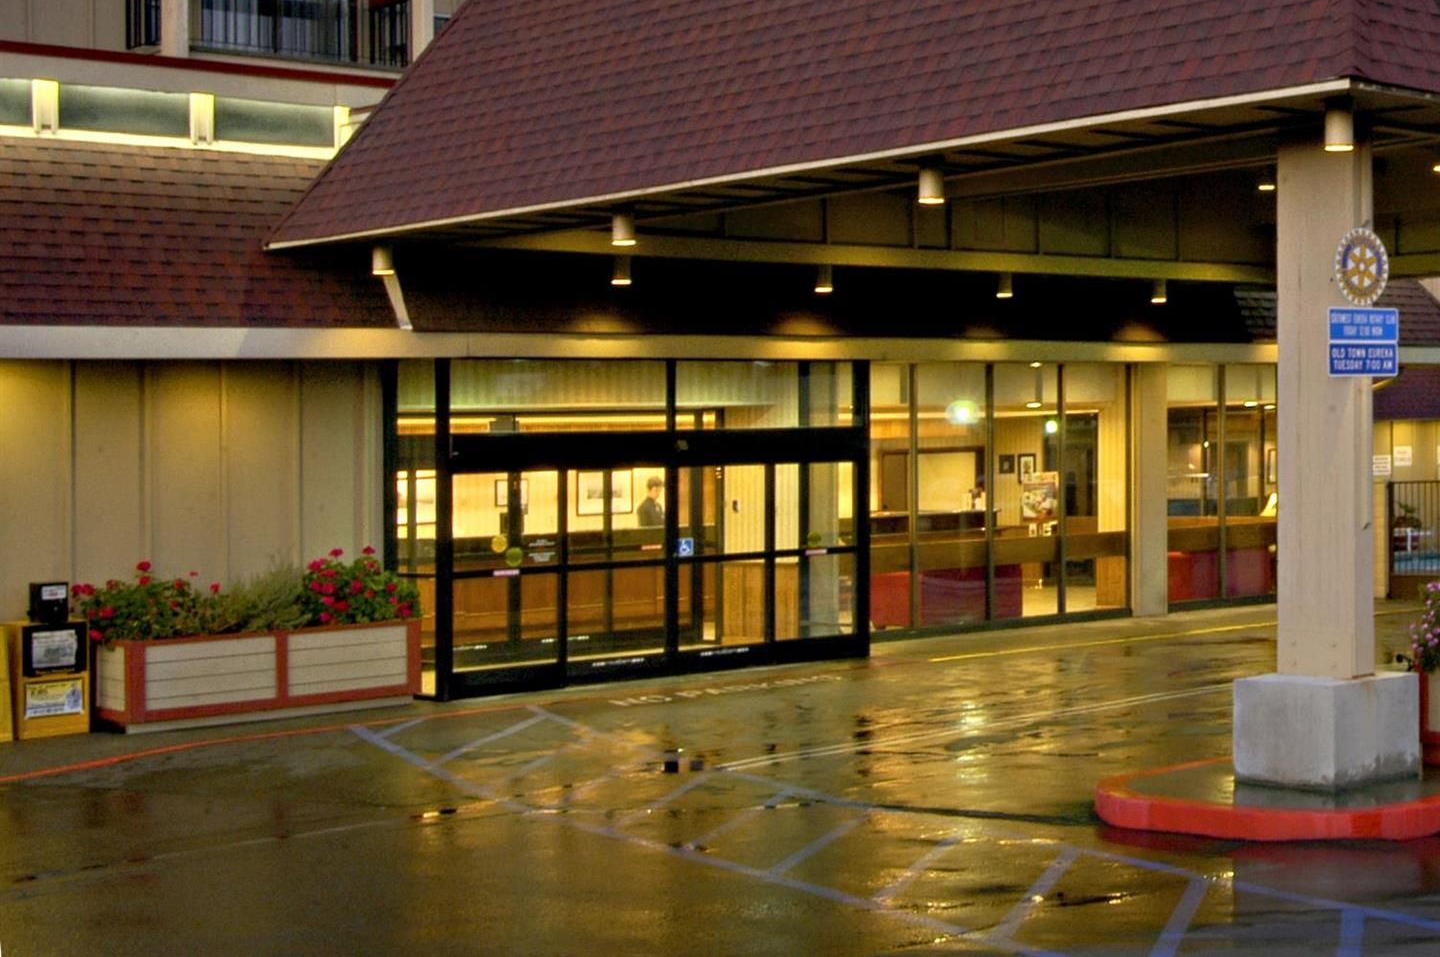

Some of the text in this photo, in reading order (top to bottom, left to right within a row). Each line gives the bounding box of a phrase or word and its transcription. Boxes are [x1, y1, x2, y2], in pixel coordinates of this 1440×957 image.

[1331, 347, 1393, 359] OLD TOWN EUREKA
[1333, 359, 1363, 371] TUESDAY
